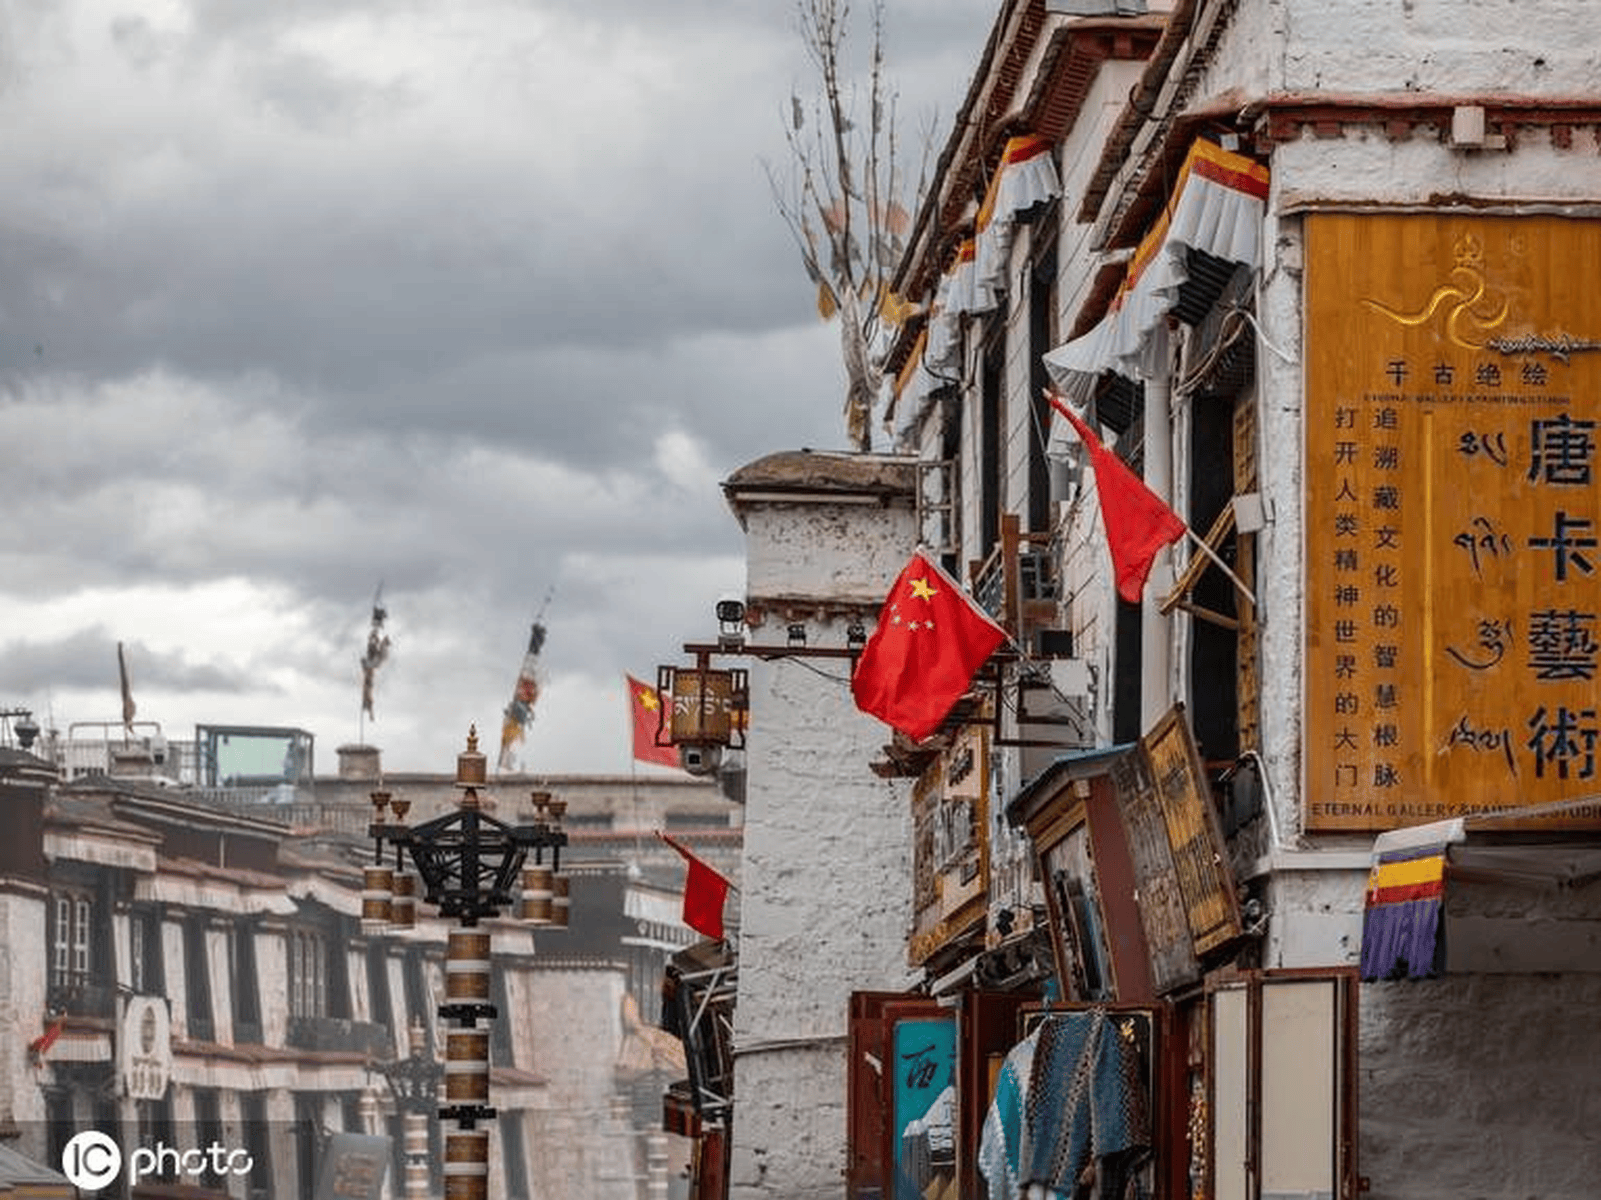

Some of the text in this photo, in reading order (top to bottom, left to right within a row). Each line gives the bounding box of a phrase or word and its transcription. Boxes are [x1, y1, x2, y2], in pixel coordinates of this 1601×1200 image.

[1386, 361, 1547, 387] 千古绝绘
[1335, 407, 1358, 787] 打开人类精神世界的大门
[1372, 407, 1399, 787] 追溯藏文化的智慧根脉
[1528, 413, 1598, 780] 唐卡藝術
[1312, 803, 1381, 816] ETERNAL
